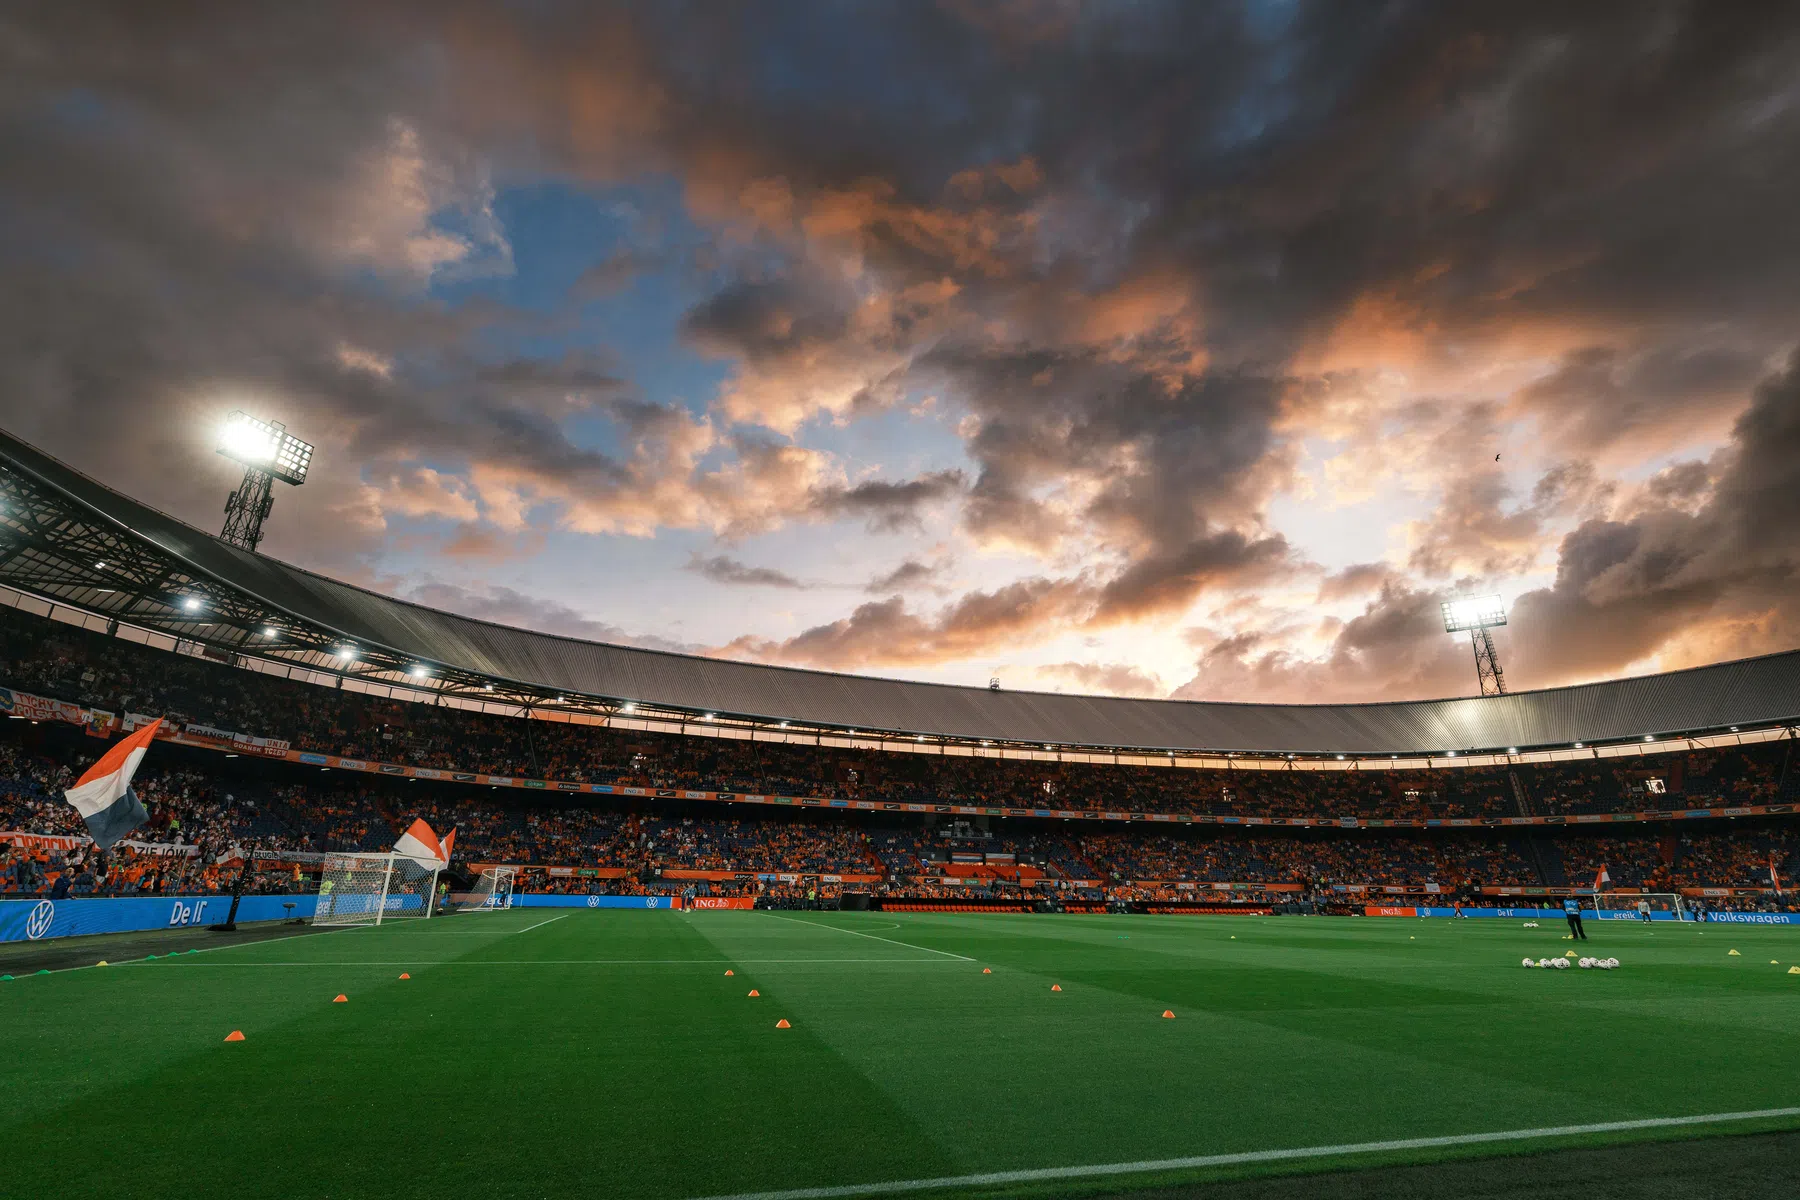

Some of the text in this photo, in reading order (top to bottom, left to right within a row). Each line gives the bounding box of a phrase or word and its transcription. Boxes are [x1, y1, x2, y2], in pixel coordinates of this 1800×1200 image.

[16, 693, 56, 710] TYCHY
[17, 704, 67, 721] POLSKA
[267, 739, 288, 750] UNIA
[264, 747, 287, 757] TCZEW
[341, 760, 355, 768] ING
[416, 769, 430, 777] ING
[695, 899, 715, 908] ING
[169, 901, 190, 925] De
[1614, 911, 1636, 919] ereik
[1708, 912, 1790, 924] Volkswagen
